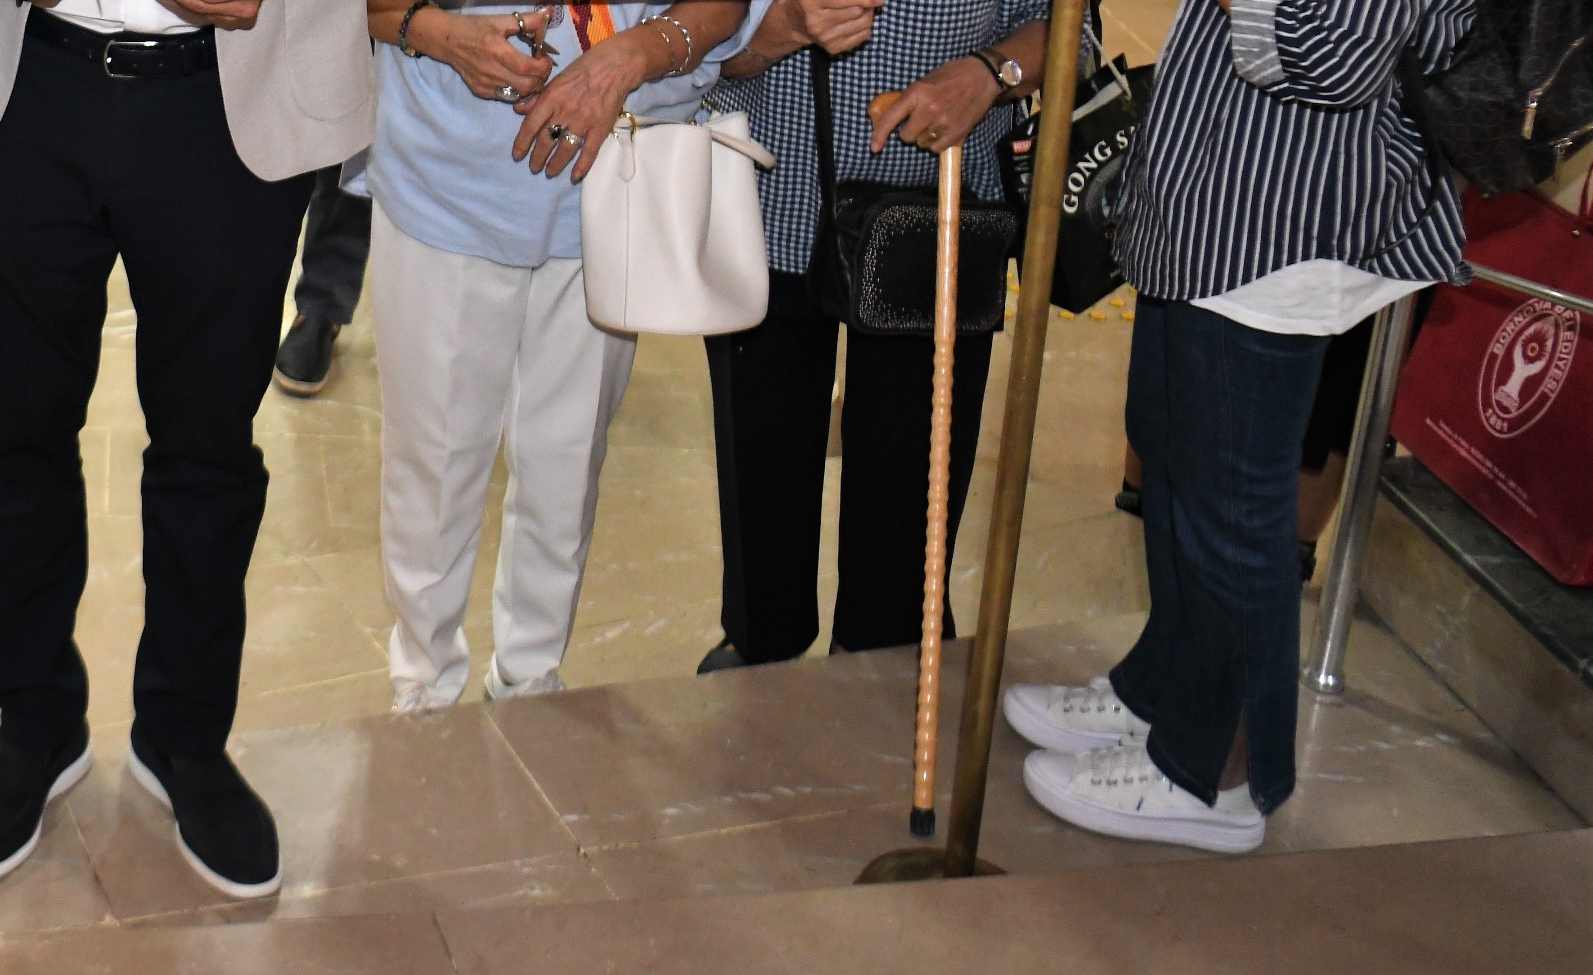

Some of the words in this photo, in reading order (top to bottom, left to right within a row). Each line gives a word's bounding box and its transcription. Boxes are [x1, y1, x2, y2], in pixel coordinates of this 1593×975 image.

[1063, 139, 1113, 215] GONG
[1115, 126, 1135, 150] S
[1492, 301, 1552, 355] BORNOVA
